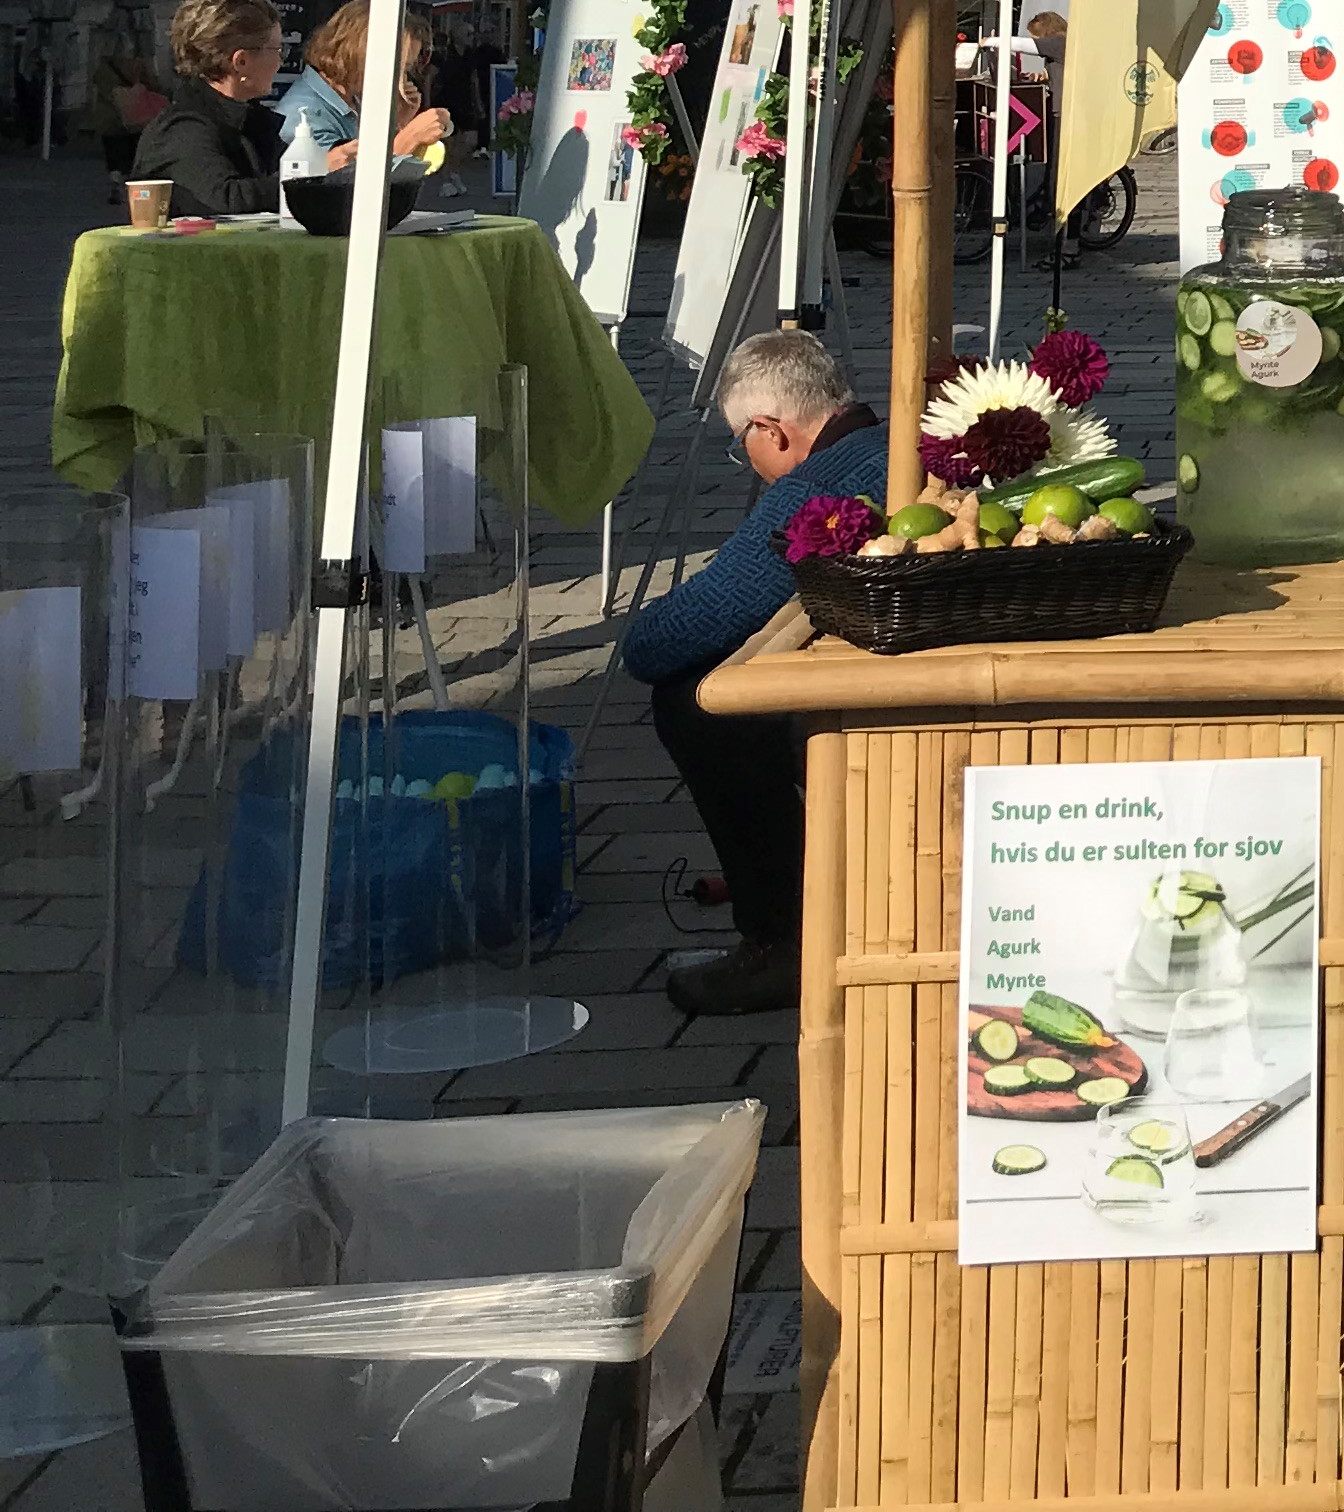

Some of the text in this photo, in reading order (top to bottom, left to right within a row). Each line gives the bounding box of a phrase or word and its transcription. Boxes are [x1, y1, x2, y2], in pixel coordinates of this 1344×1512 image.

[1251, 370, 1279, 379] Agurk
[991, 796, 1164, 825] Snup en drink,
[990, 836, 1283, 864] hvis du er sulten for sjov
[988, 905, 1035, 923] Vand
[987, 938, 1041, 958] Agurk
[986, 972, 1046, 992] Mynte
